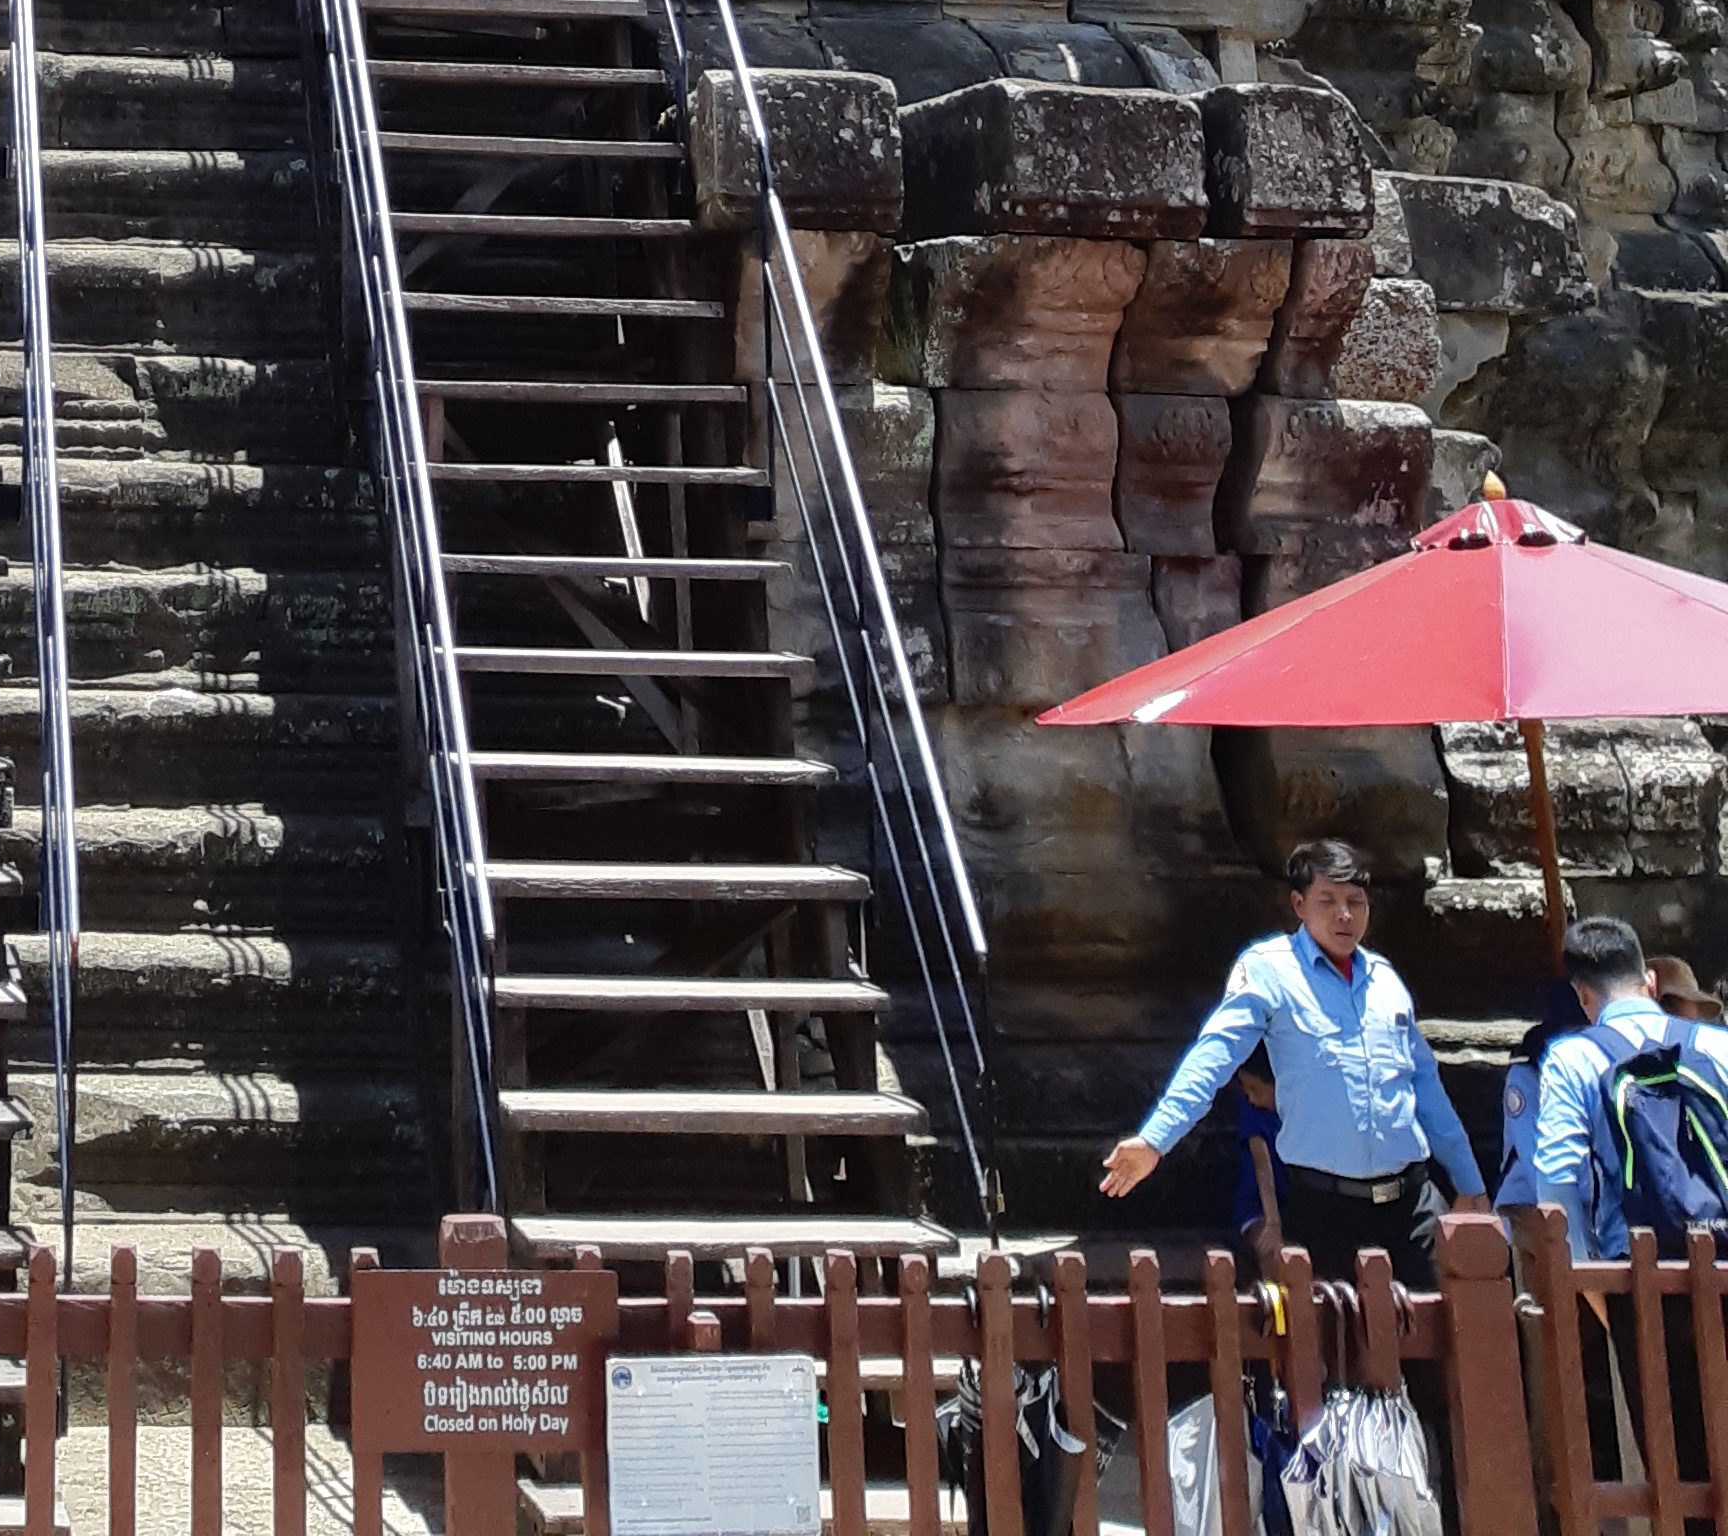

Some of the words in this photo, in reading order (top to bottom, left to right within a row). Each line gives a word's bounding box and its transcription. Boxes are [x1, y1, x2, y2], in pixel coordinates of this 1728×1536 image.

[431, 1331, 496, 1346] VISITING
[499, 1331, 553, 1346] HOURS
[417, 1353, 452, 1370] 6:40
[455, 1353, 483, 1369] AM
[487, 1354, 504, 1369] to
[513, 1354, 547, 1370] 5:00
[551, 1354, 578, 1370] PM
[424, 1414, 474, 1432] Closed
[478, 1417, 498, 1432] on
[502, 1414, 536, 1436] Holy
[539, 1414, 569, 1436] Day
